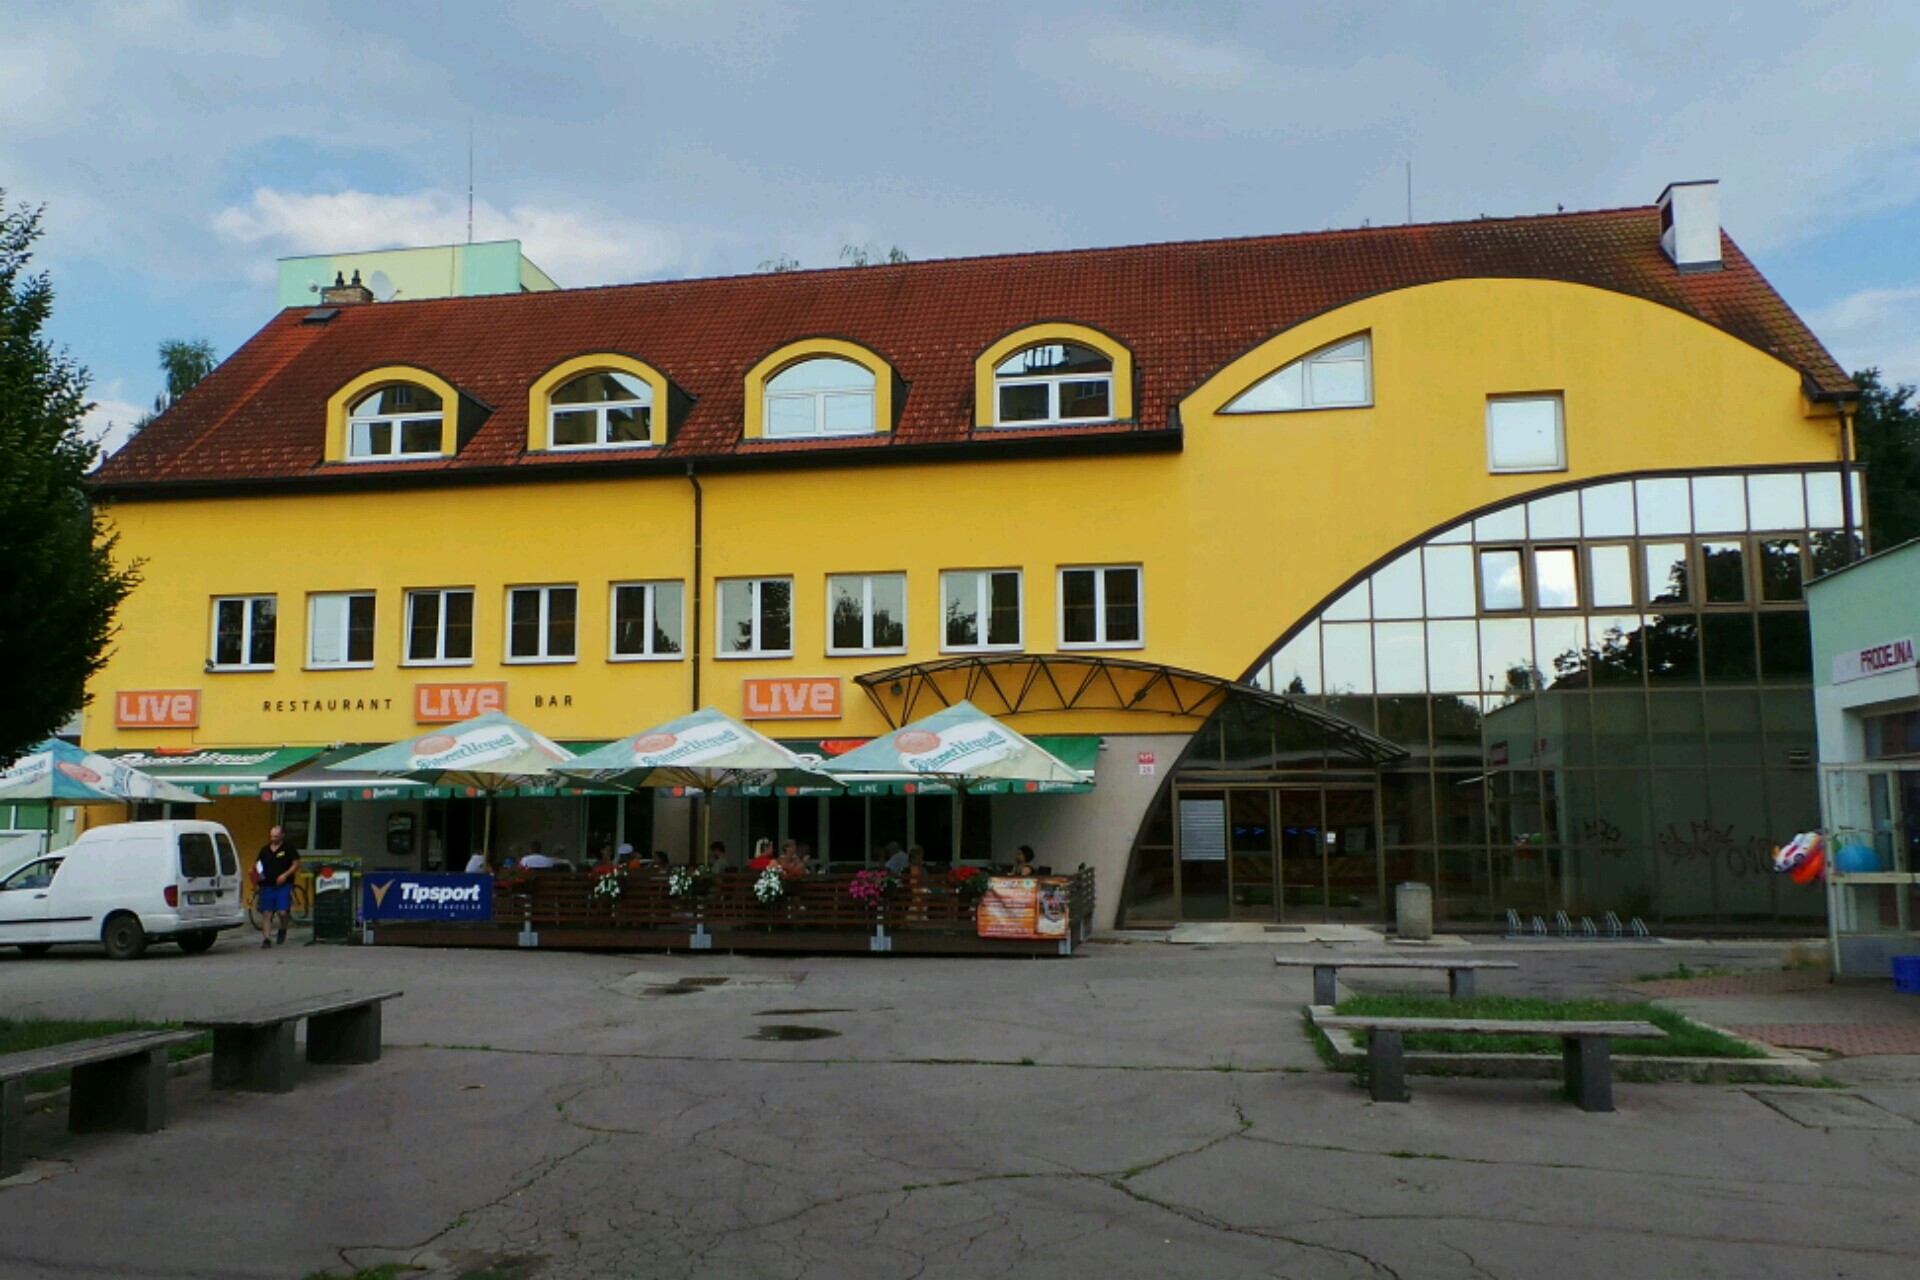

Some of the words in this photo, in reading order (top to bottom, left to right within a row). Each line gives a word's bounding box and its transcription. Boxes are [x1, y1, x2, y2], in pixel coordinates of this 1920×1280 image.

[263, 699, 392, 712] RESTAURANT
[534, 695, 573, 707] BAR
[400, 882, 480, 904] Tipsport
